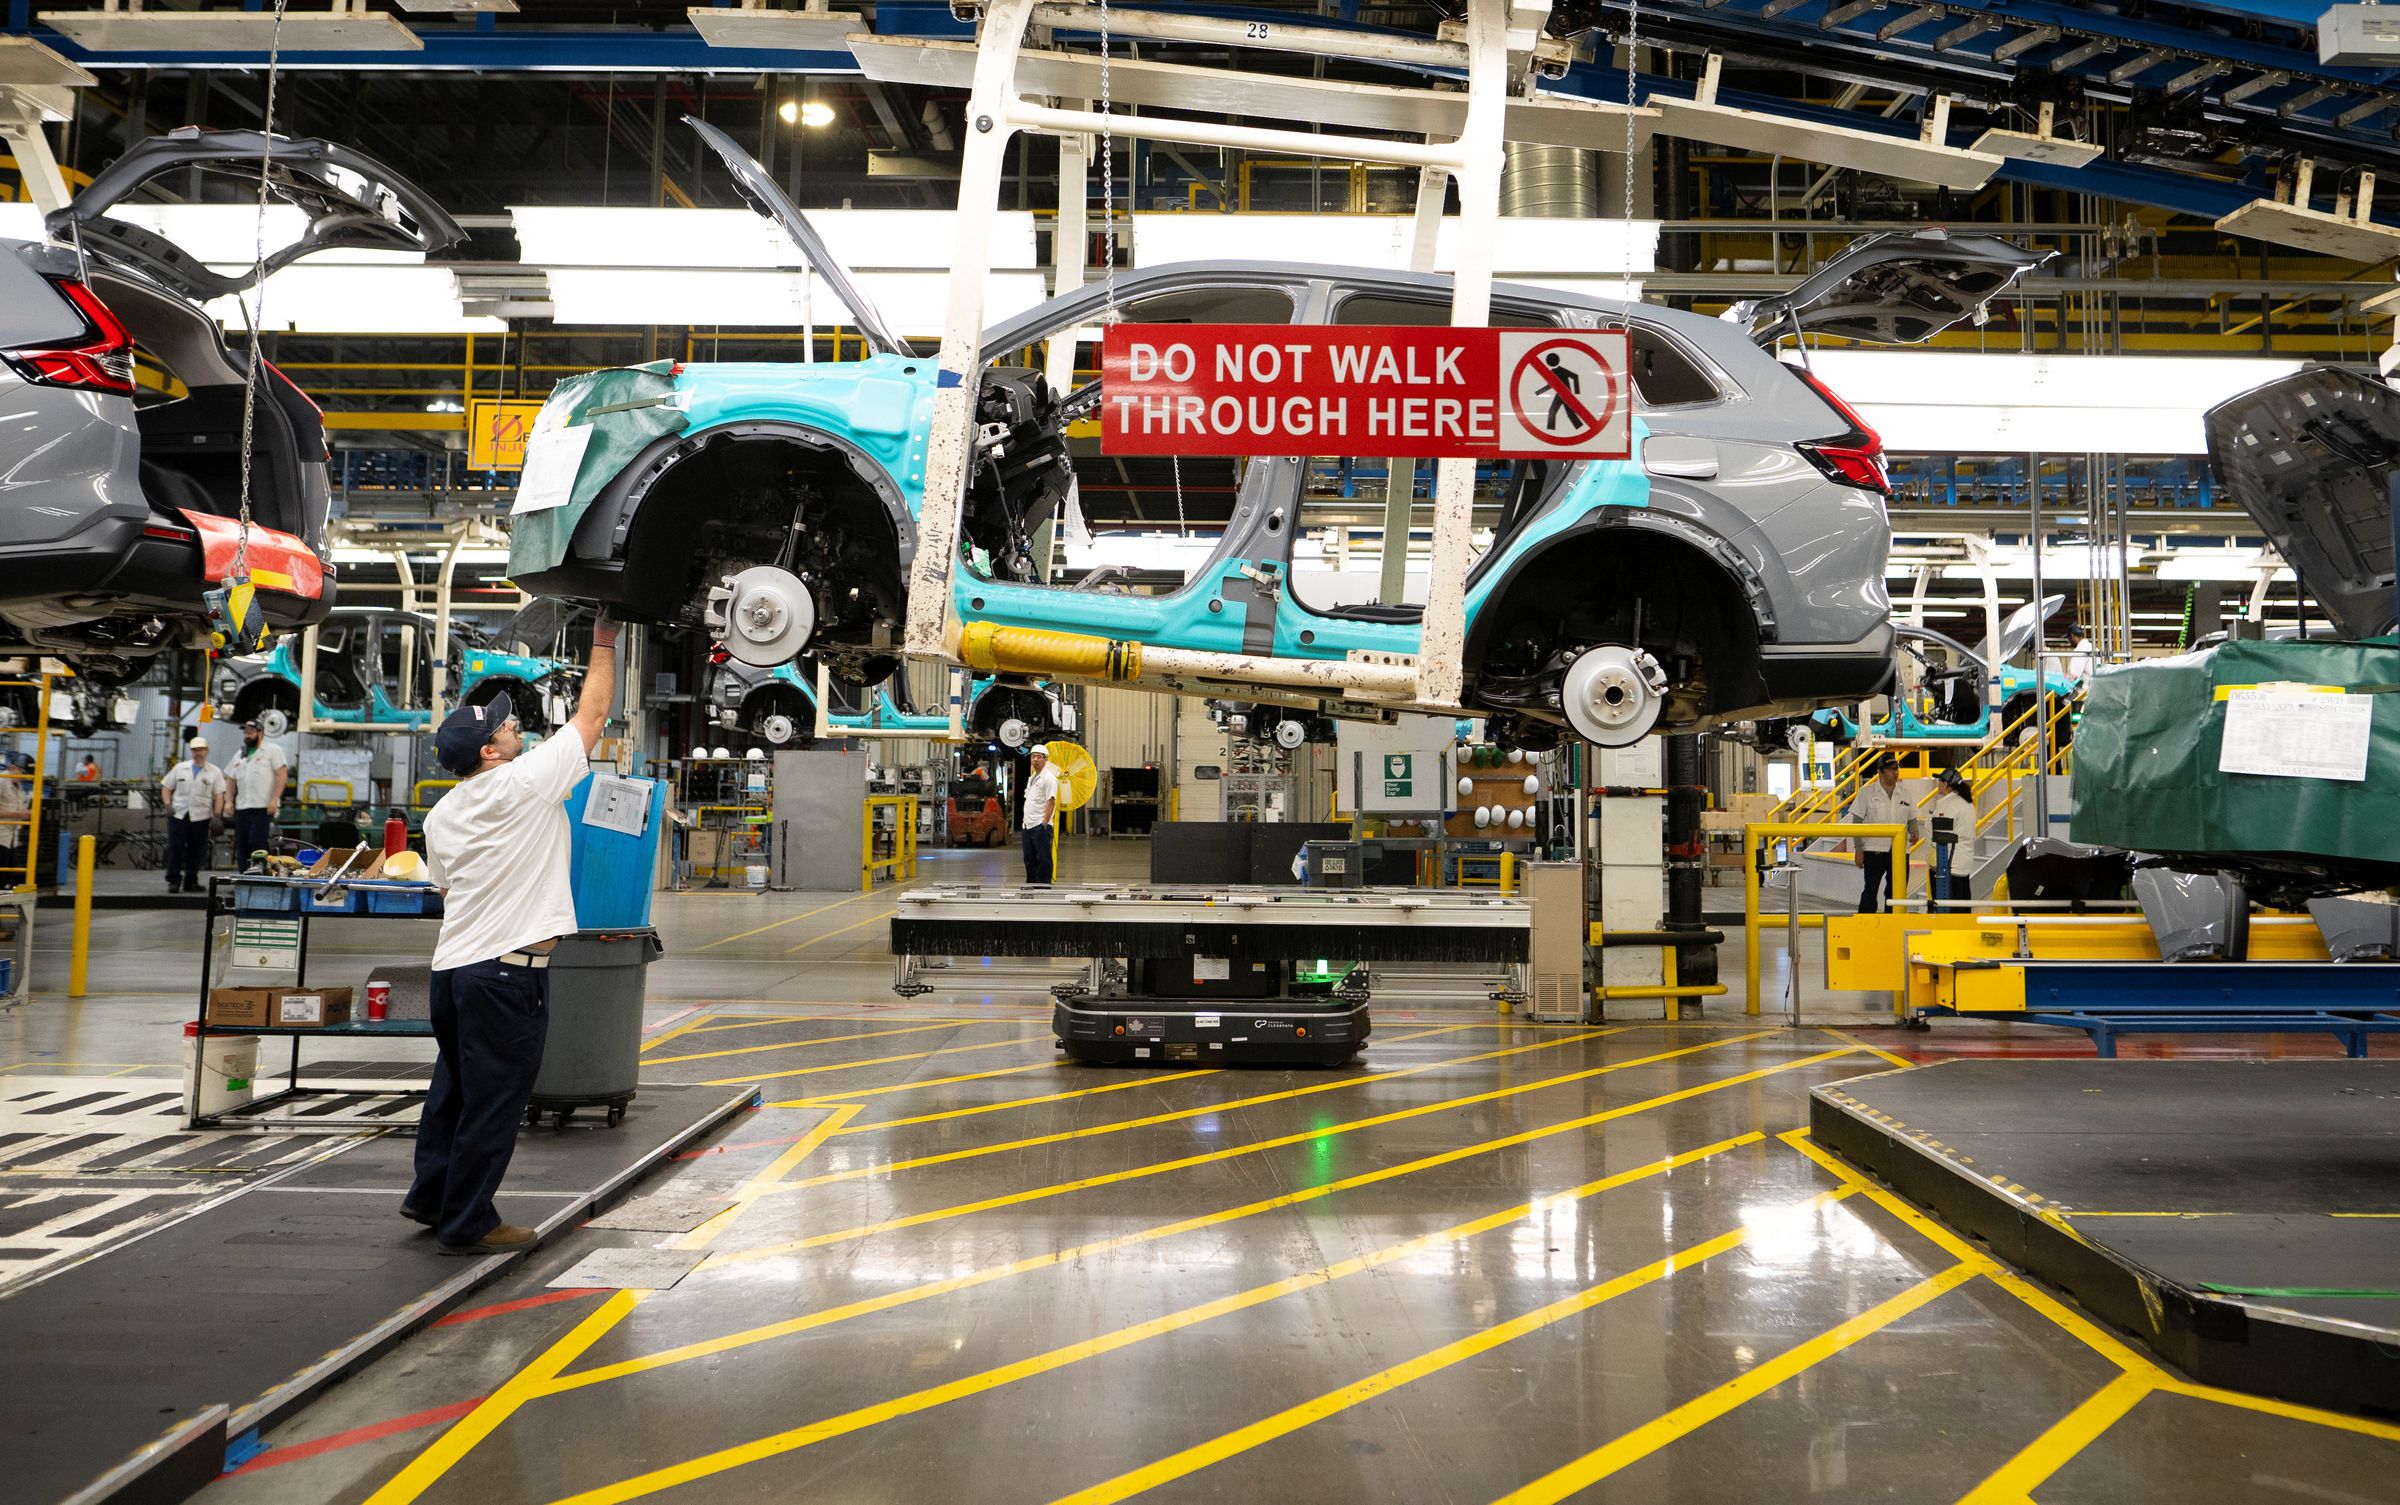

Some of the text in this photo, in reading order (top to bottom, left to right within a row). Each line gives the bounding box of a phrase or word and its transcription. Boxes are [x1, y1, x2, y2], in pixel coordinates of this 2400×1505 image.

[1247, 23, 1268, 39] 28
[1130, 343, 1467, 386] DO NOT WALK
[1112, 394, 1495, 438] THROUGH HERE
